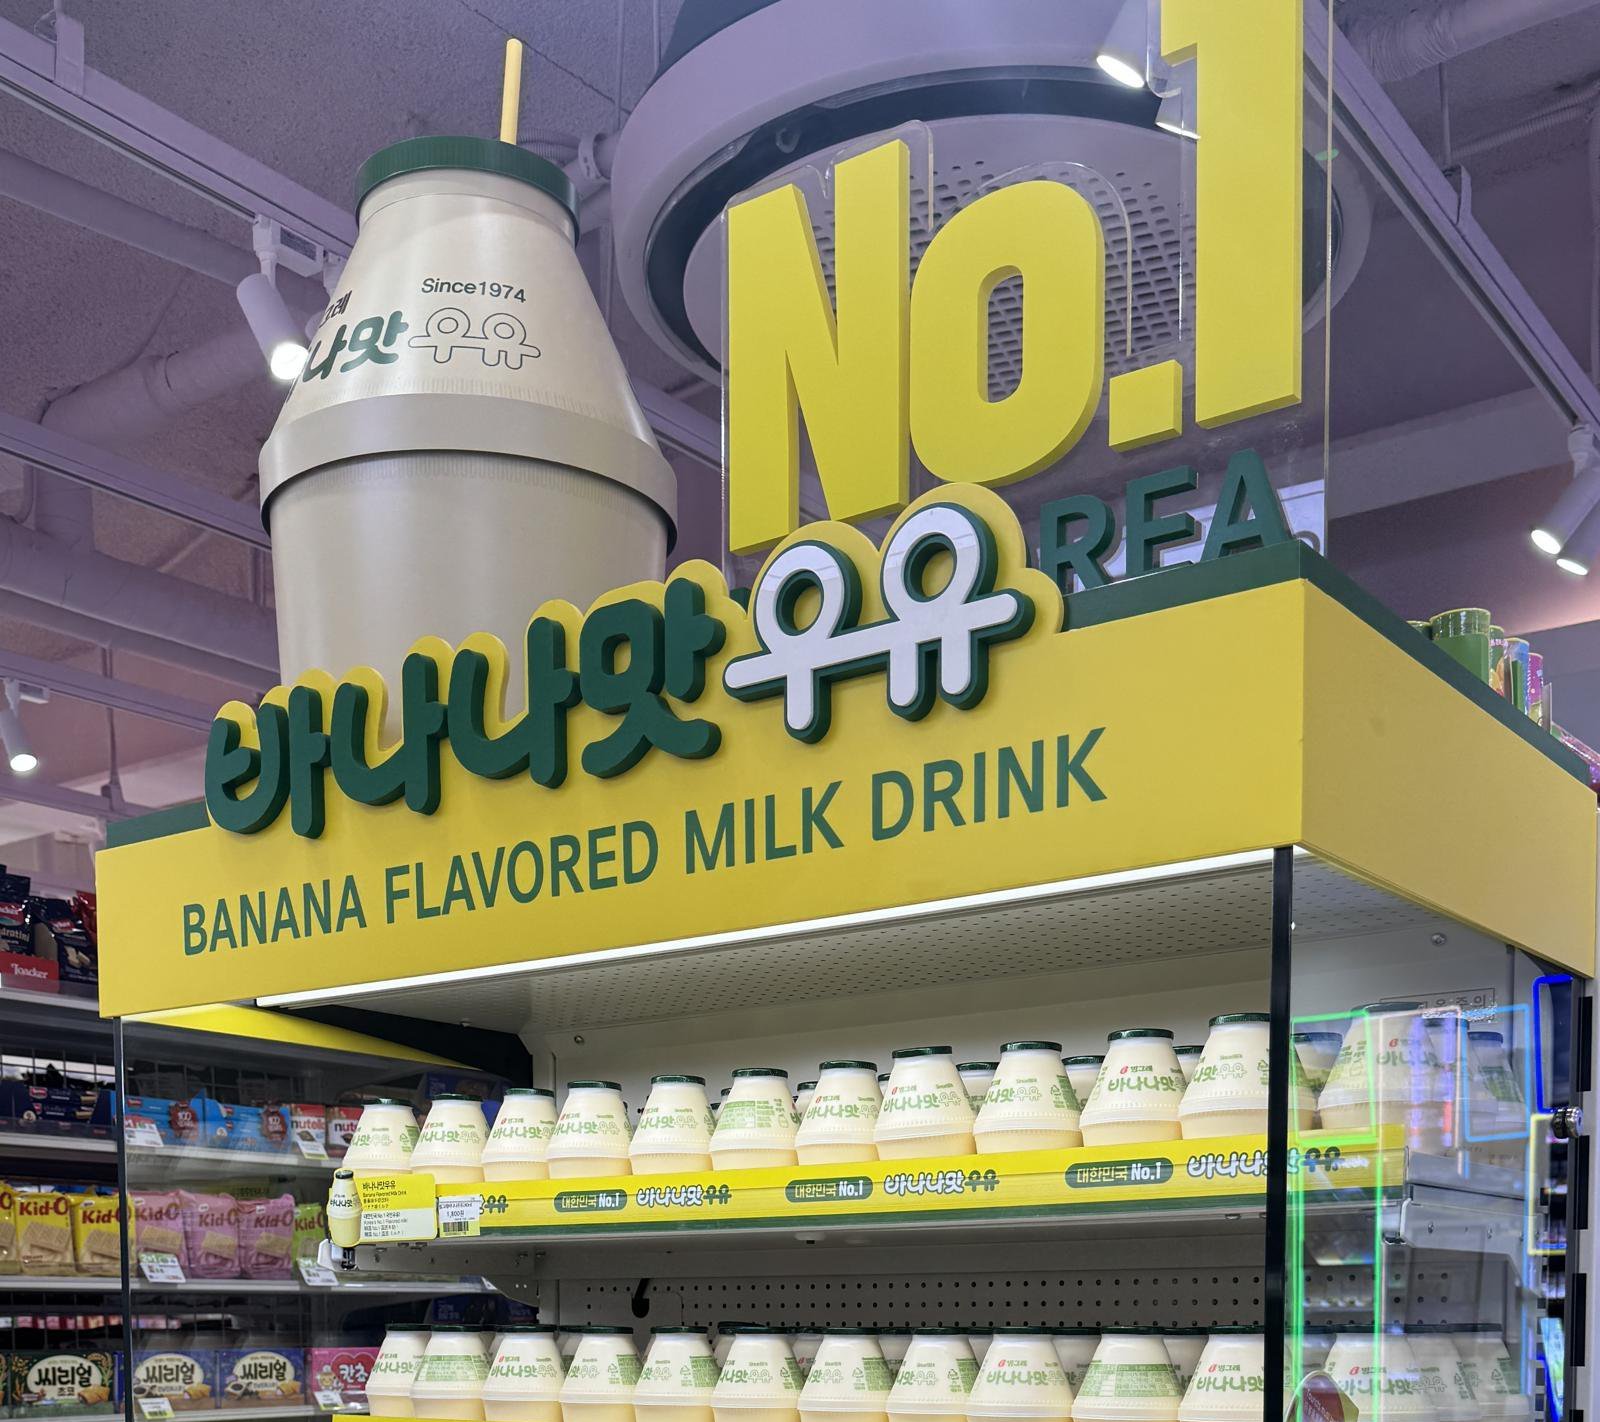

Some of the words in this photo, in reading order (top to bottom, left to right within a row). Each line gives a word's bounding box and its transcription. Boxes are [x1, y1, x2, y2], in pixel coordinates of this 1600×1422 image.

[421, 277, 527, 303] Since1974
[728, 0, 1303, 556] No.1
[182, 874, 367, 957] BANANA
[385, 820, 659, 925] FLAVORED
[685, 780, 845, 875] MILK
[872, 726, 1108, 842] DRINK
[795, 1184, 836, 1198] 대한민국
[839, 1180, 864, 1197] No.1
[884, 1169, 1000, 1195] 바나나맛우유
[1076, 1165, 1128, 1183] 대한민국
[1131, 1162, 1162, 1181] No.1
[20, 1197, 69, 1216] Kid-O
[561, 1195, 598, 1209] 대한민국
[599, 1193, 619, 1208] No.1
[636, 1184, 732, 1208] 바나나맛우유
[35, 1363, 92, 1388] 씨리얼
[143, 1361, 195, 1385] 씨리얼
[240, 1360, 287, 1382] 씨리얼
